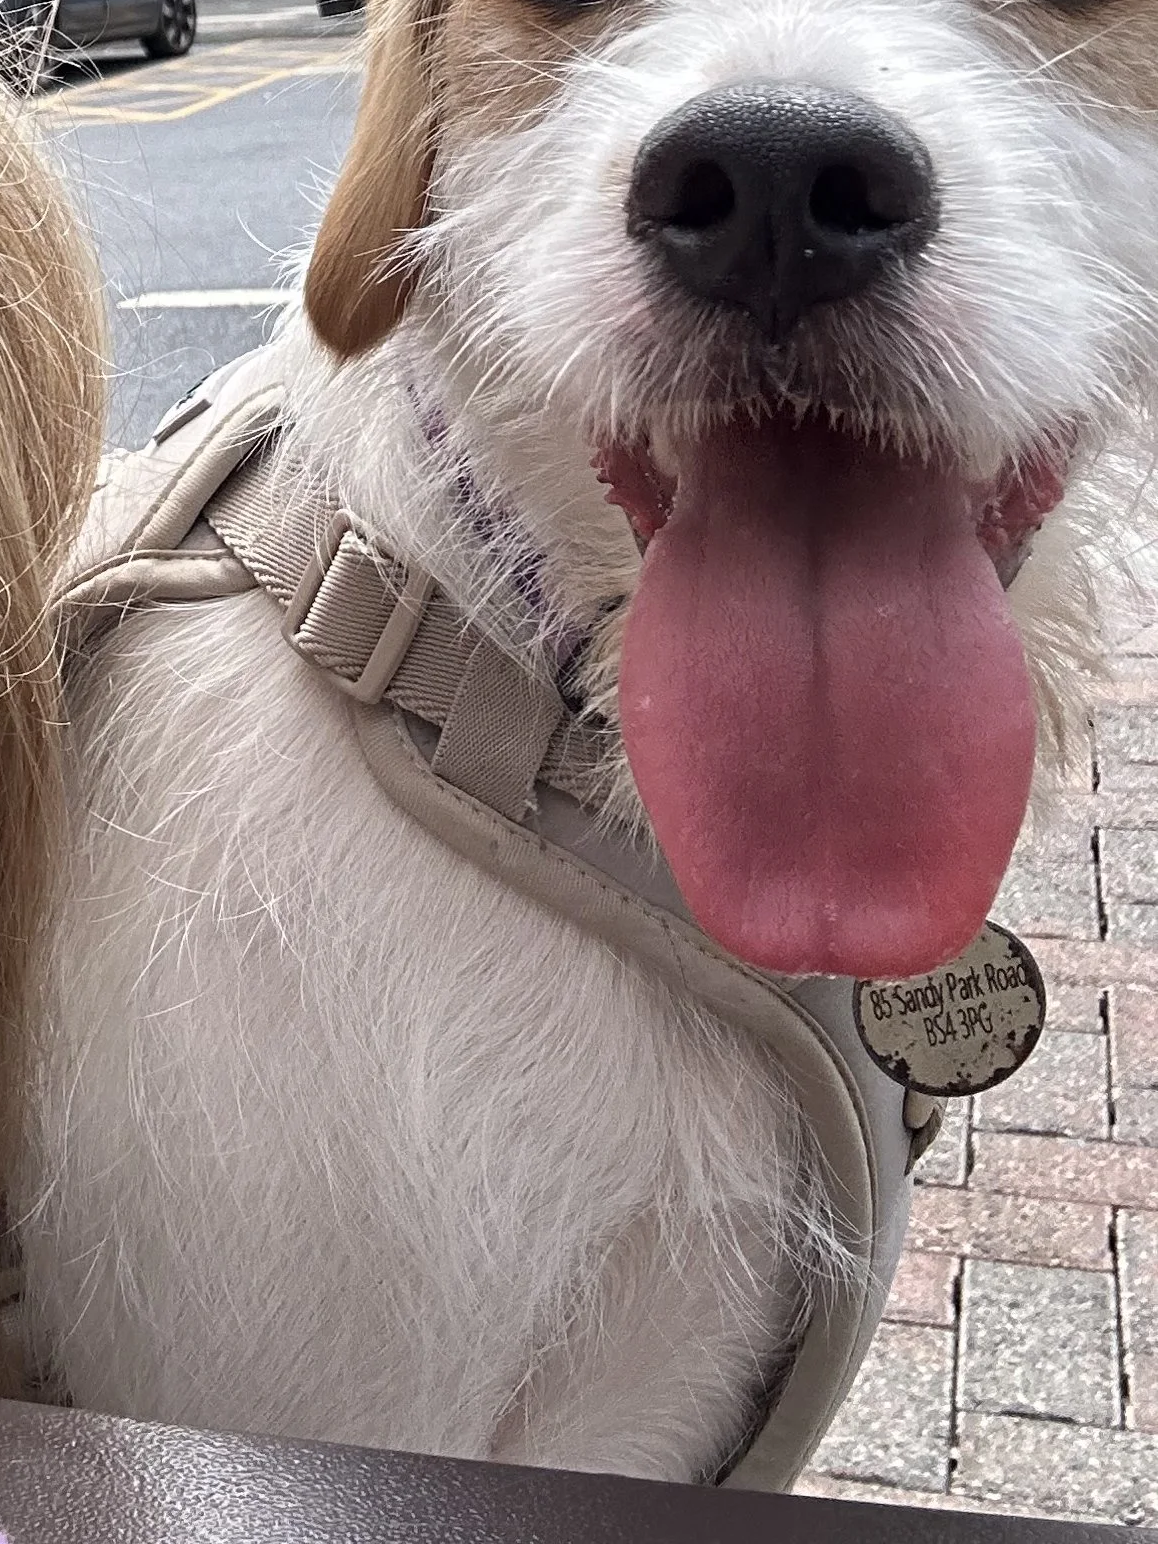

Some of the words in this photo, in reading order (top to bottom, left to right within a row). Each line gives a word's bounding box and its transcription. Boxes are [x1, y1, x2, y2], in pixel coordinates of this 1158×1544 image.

[869, 988, 893, 1021] 85
[893, 975, 944, 1015] Sandy
[945, 966, 984, 1002] Park
[923, 1012, 958, 1047] BS4
[958, 1002, 993, 1039] 3PG
